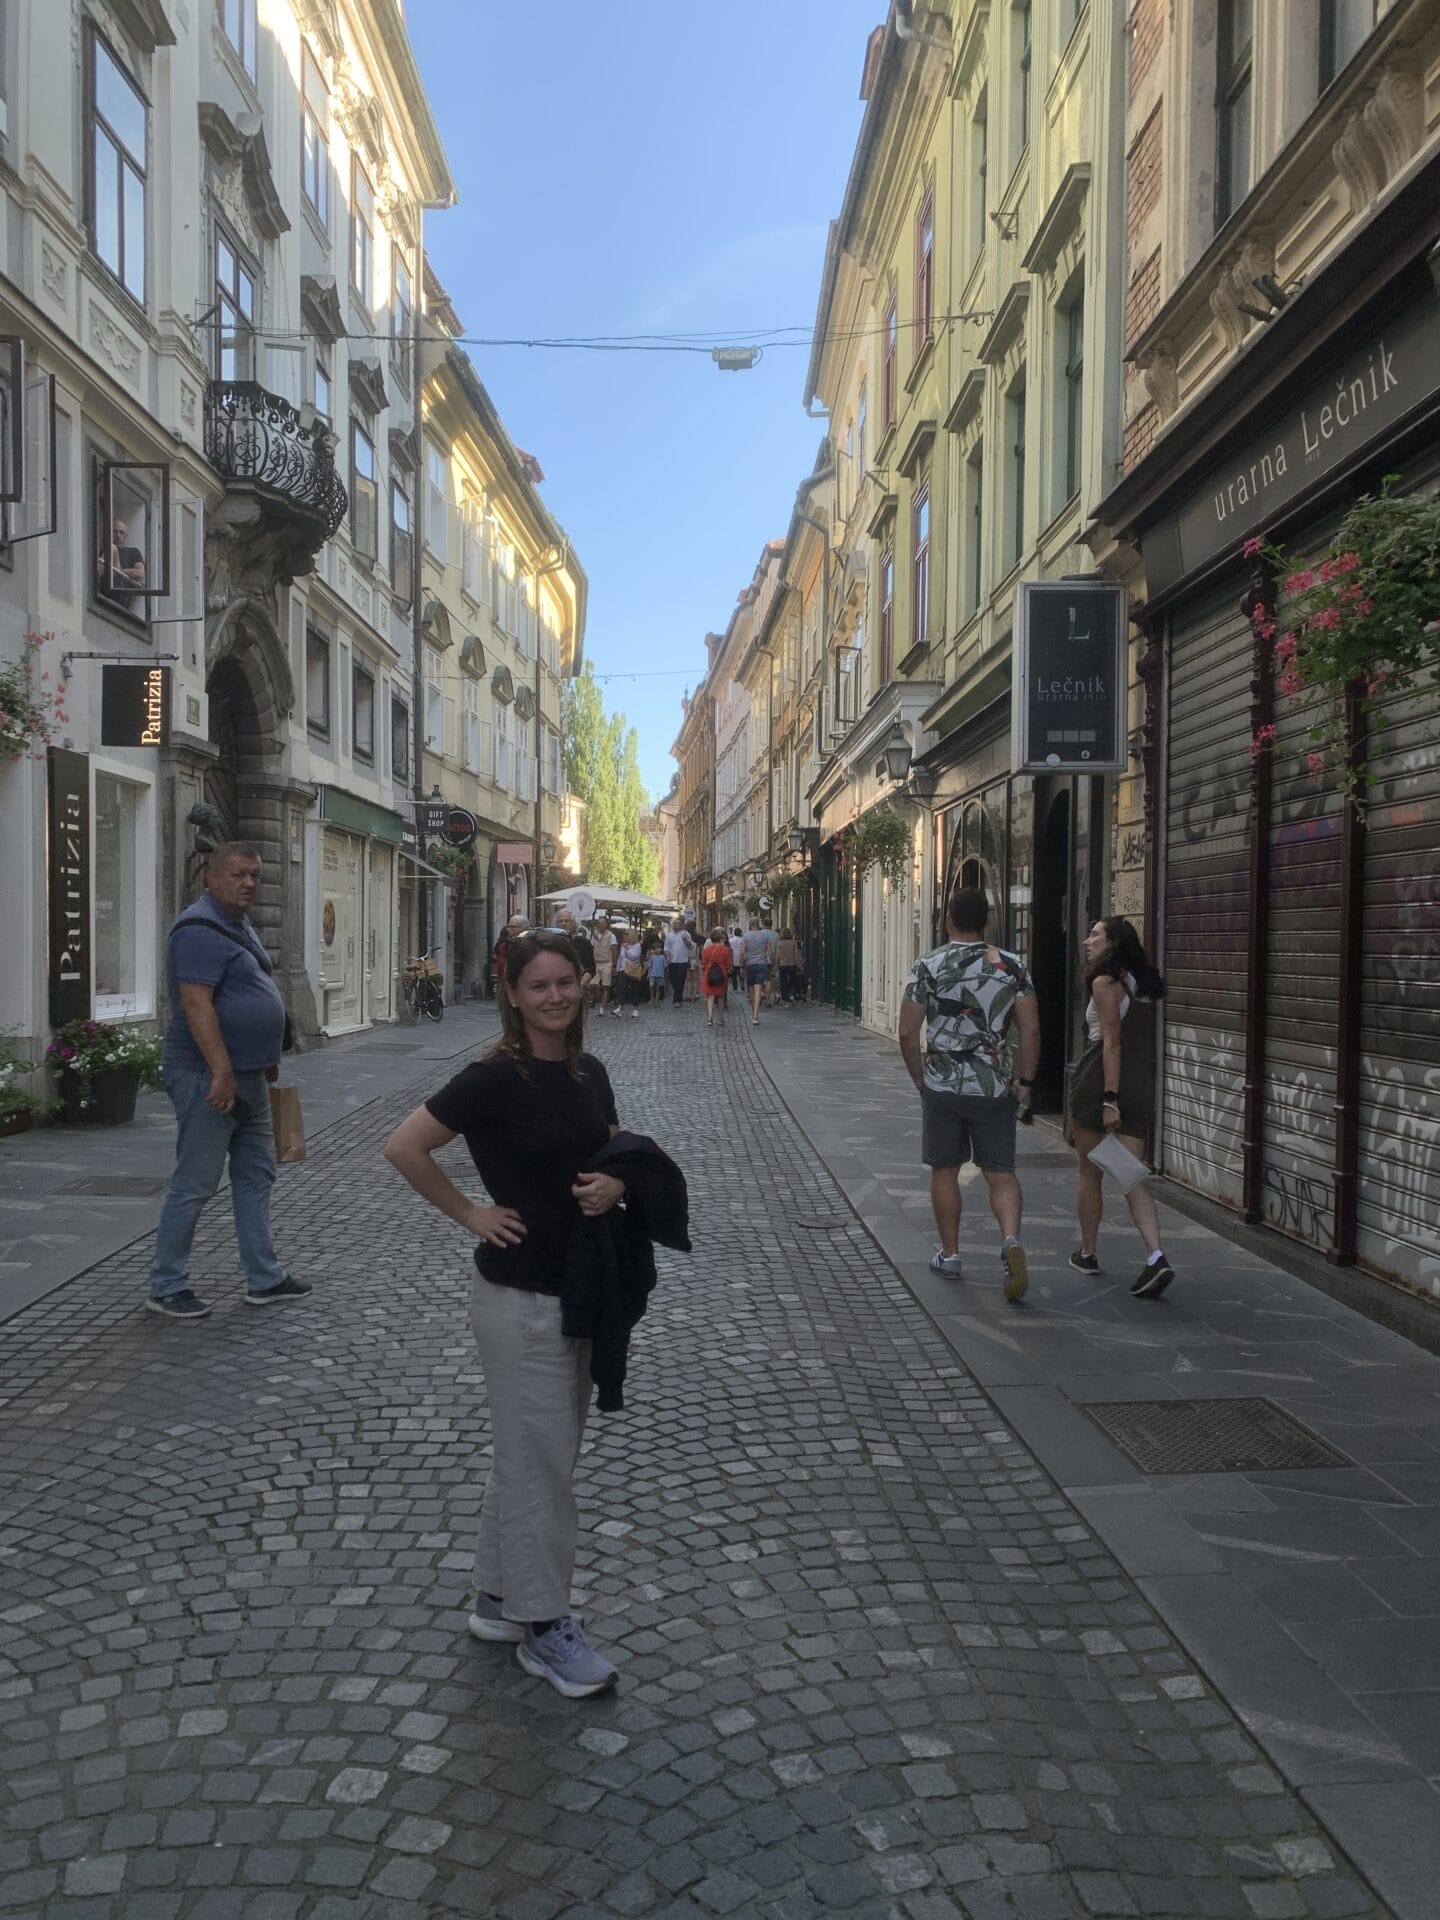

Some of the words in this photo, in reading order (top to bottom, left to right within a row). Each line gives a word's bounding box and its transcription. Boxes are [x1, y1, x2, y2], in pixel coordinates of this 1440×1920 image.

[1213, 444, 1288, 521] urarna
[1300, 341, 1399, 456] Lečnik
[141, 668, 163, 745] Patrizia
[1037, 676, 1106, 693] Lečnik
[427, 819, 444, 827] SHOP
[60, 793, 80, 981] Patrizia
